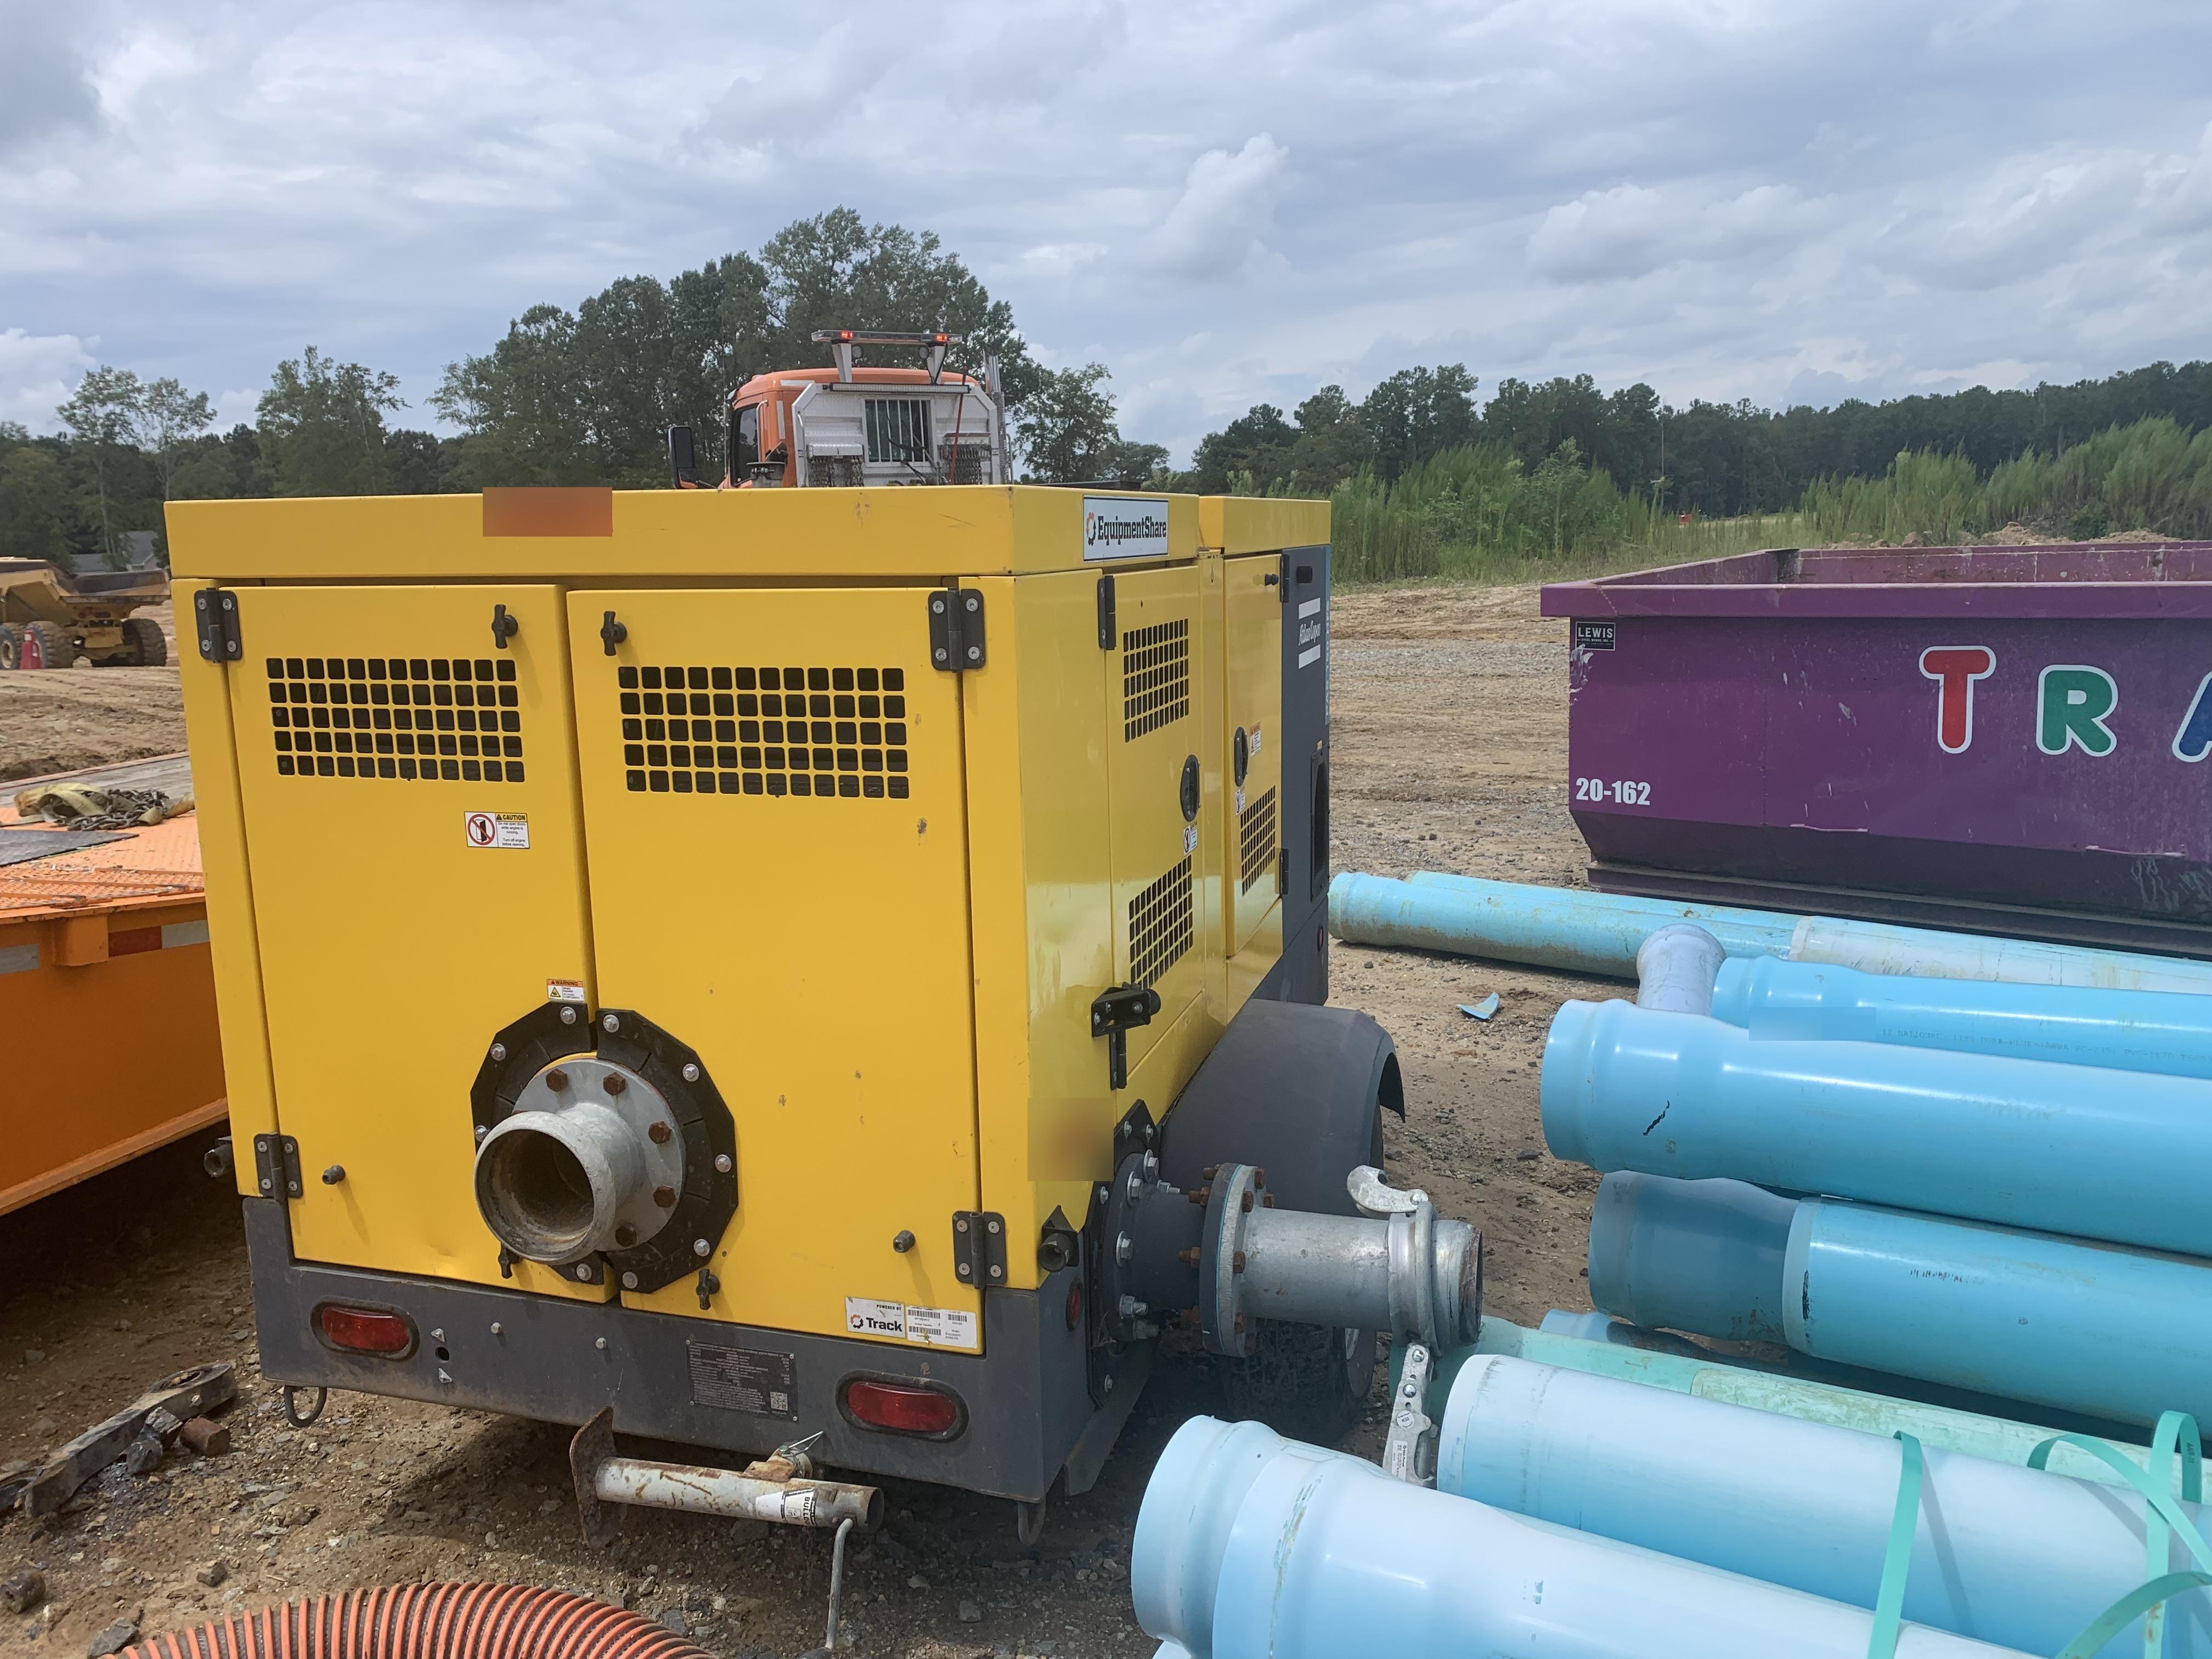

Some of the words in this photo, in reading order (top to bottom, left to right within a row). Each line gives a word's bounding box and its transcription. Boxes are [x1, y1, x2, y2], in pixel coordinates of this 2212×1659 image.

[1097, 515, 1167, 546] EquipmentShare
[1298, 623, 1311, 646] Atlas
[1310, 619, 1321, 643] Copco
[1578, 627, 1613, 638] LEWIS
[1576, 777, 1651, 806] 20-162
[1898, 1029, 1942, 1040] NATIONAL
[866, 1317, 903, 1332] Track
